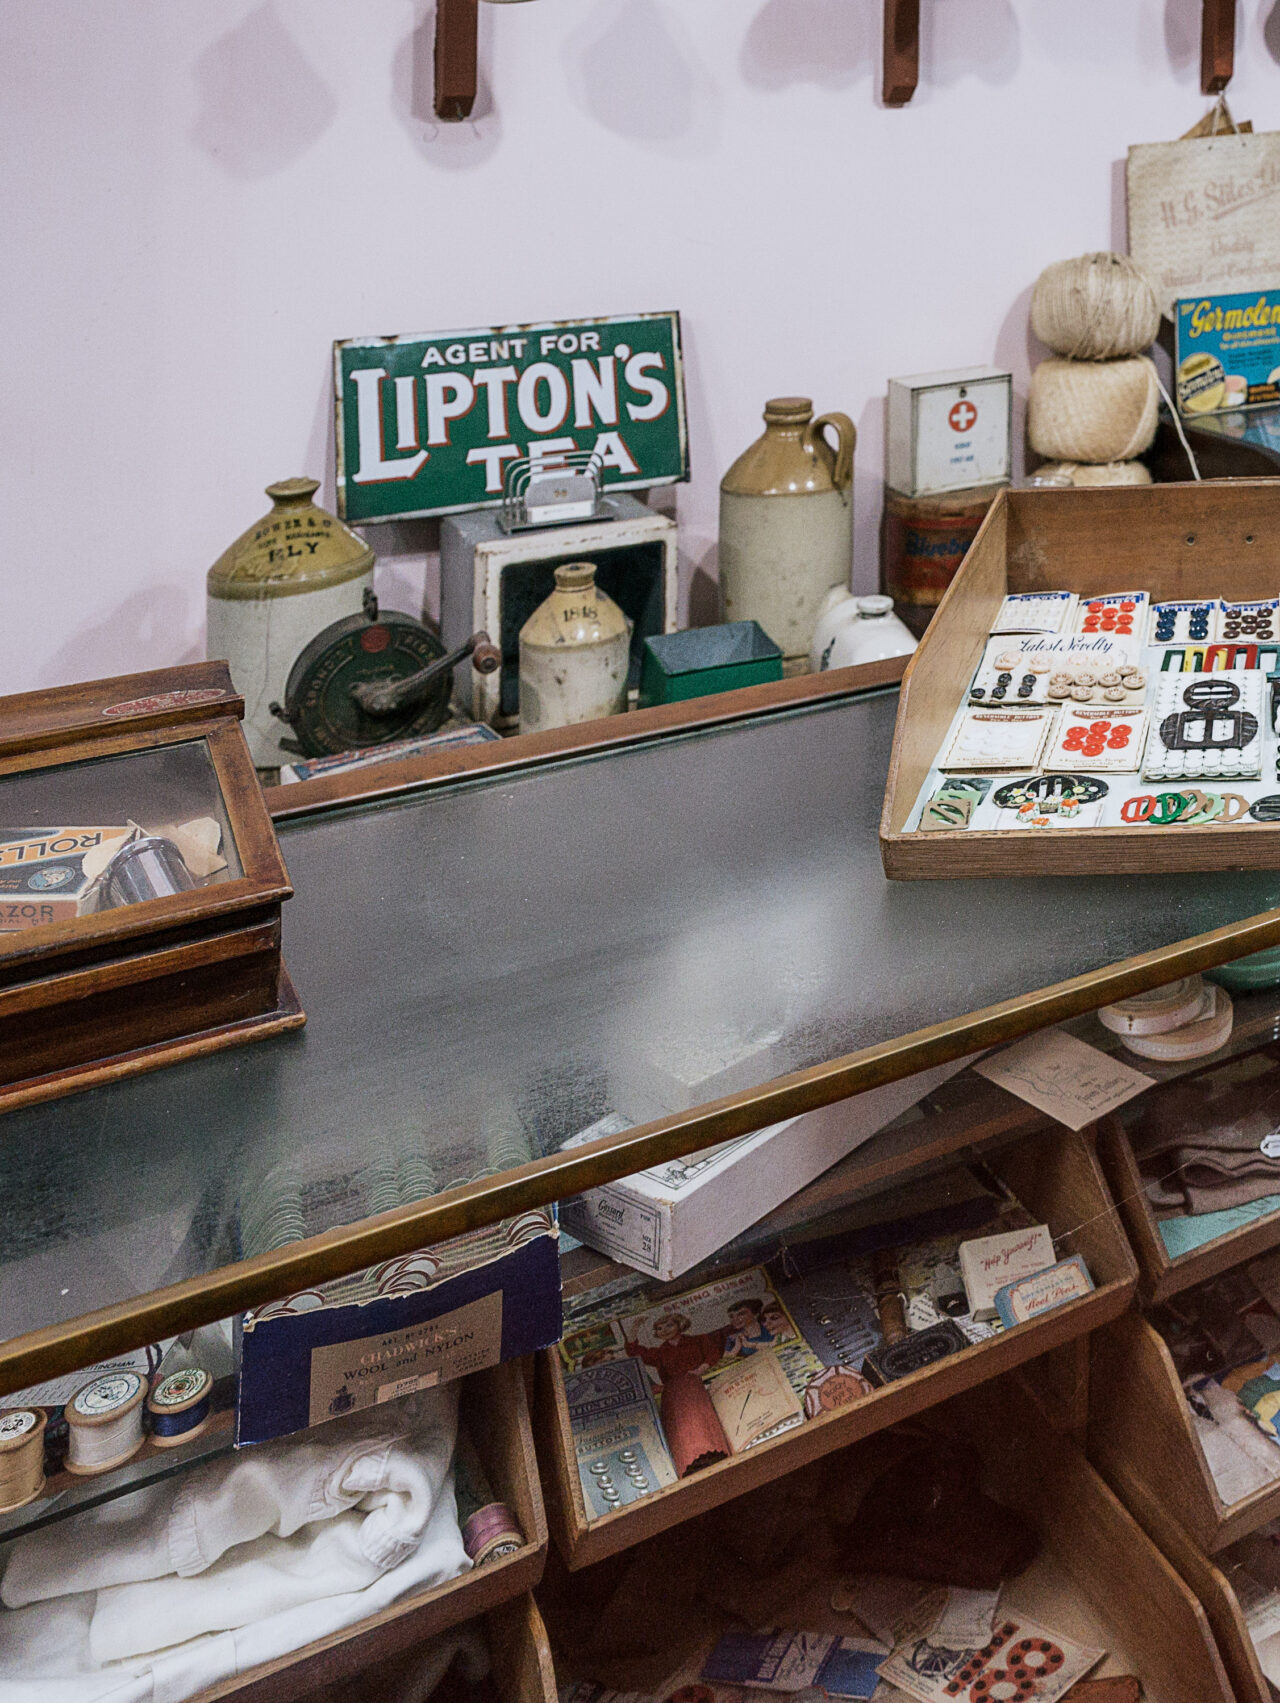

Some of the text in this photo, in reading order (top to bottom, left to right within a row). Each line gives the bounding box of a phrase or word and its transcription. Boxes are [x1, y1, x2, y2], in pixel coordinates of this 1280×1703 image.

[421, 331, 603, 369] AGENT FOR
[349, 343, 672, 486] LIPTON'S
[465, 430, 643, 494] TEA
[1019, 634, 1114, 654] Latest Novelty
[641, 1241, 652, 1254] 28
[663, 1274, 754, 1313] SEWING SUSAN
[343, 1331, 476, 1381] WOOL and NYLON
[359, 1326, 459, 1366] CHADWICK'S
